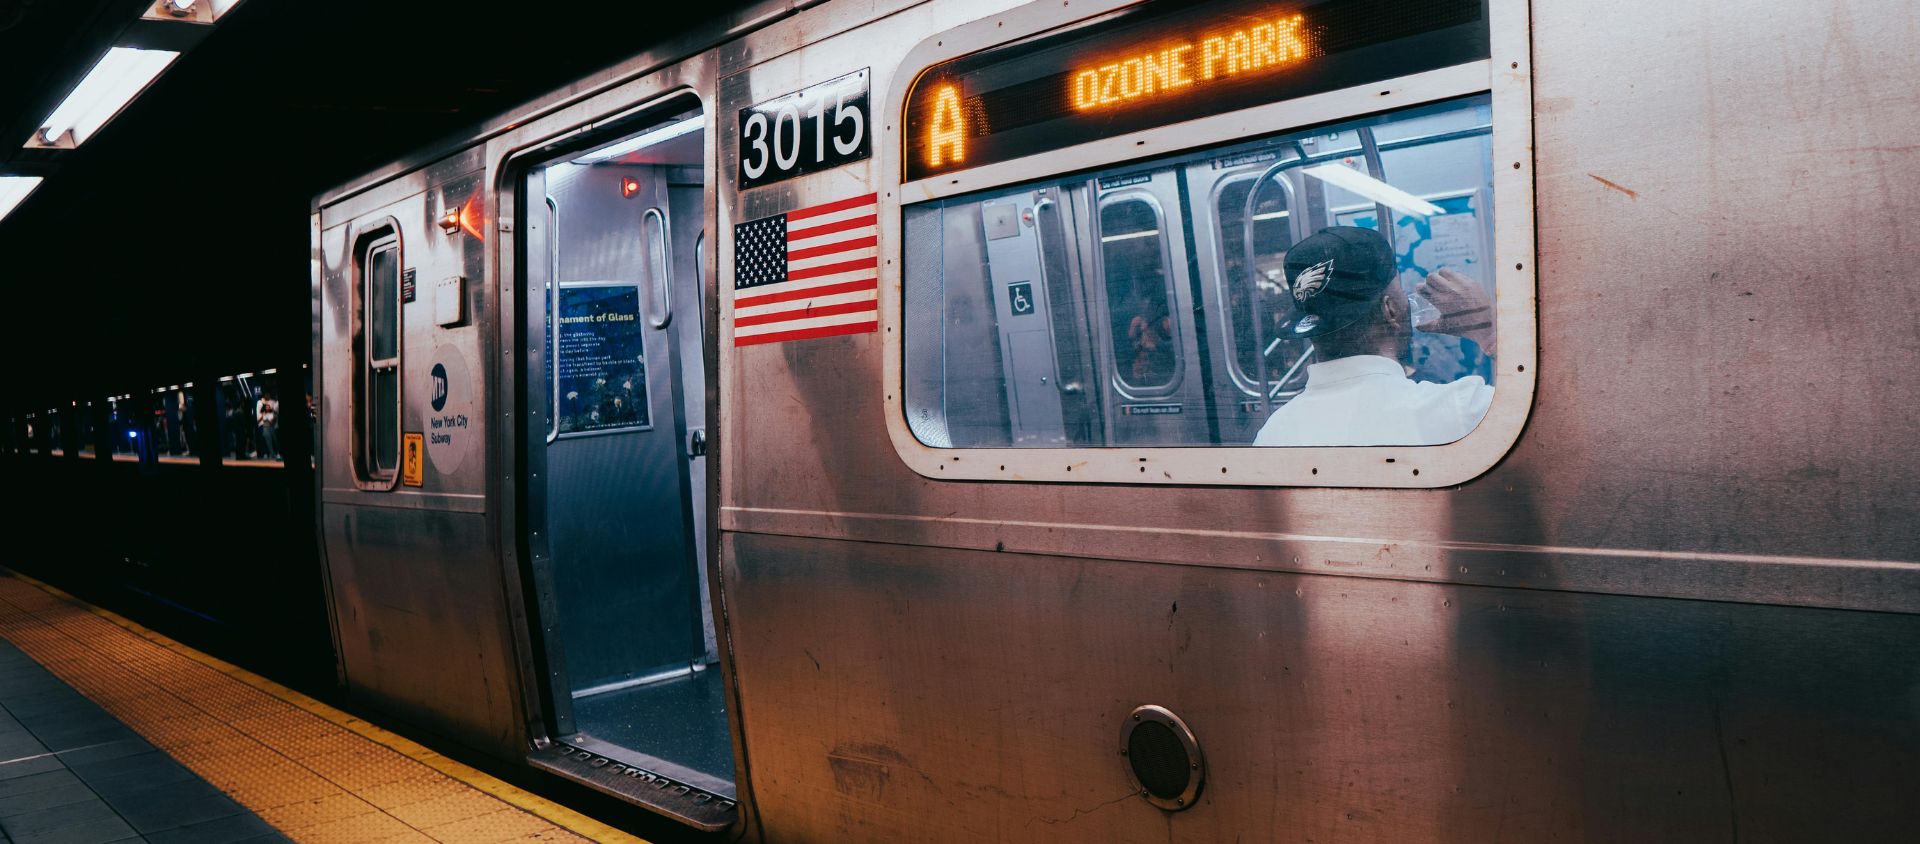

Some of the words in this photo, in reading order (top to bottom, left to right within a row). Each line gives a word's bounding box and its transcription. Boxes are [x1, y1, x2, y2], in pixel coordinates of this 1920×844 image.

[930, 86, 964, 167] A
[1074, 44, 1192, 110] OZONE
[1203, 15, 1302, 80] PARK
[743, 87, 863, 179] 3015
[596, 313, 606, 322] of
[608, 312, 634, 321] Glass
[431, 417, 443, 429] New
[443, 415, 456, 428] York
[456, 414, 468, 429] City
[431, 432, 451, 445] Subway
